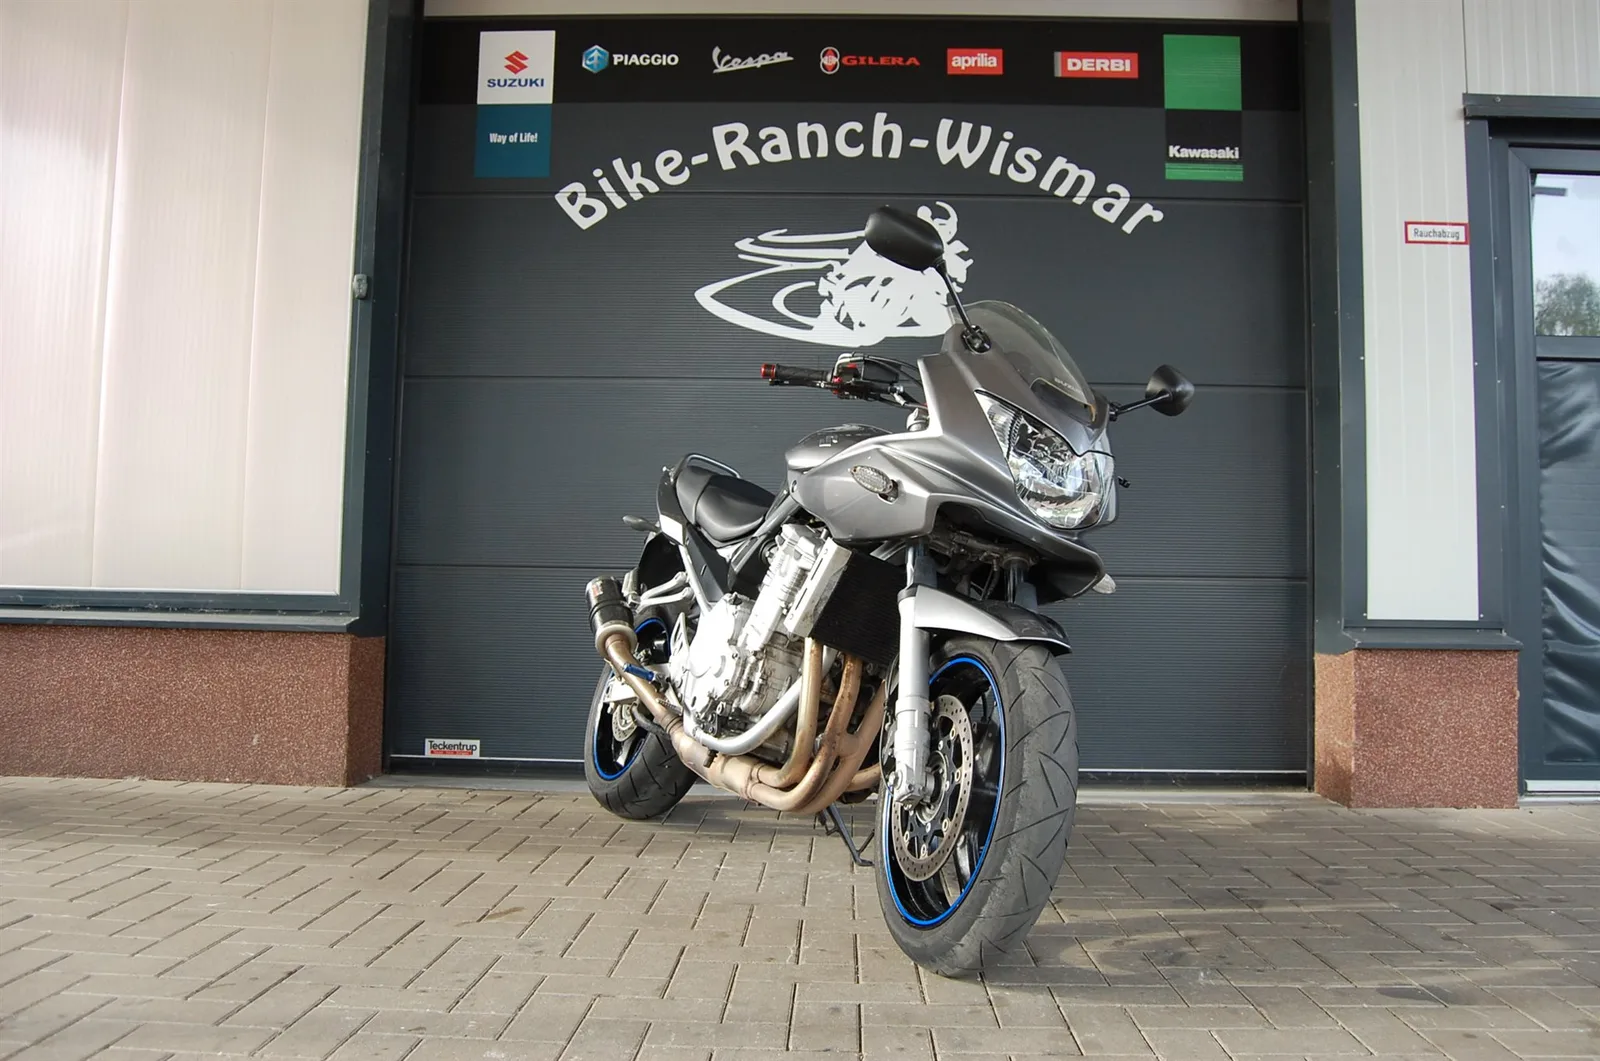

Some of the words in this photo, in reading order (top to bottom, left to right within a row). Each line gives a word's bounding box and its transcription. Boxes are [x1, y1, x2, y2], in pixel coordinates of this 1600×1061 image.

[612, 53, 680, 66] PIAGGIO
[712, 46, 794, 74] Vespa
[841, 55, 921, 66] GILERA
[951, 53, 998, 70] aprilia
[1067, 58, 1131, 72] DERBI
[487, 78, 545, 88] SUZUKI
[489, 133, 507, 145] Way
[508, 133, 518, 143] of
[520, 132, 538, 143] Life!
[1168, 145, 1240, 159] Kawasaki
[1413, 228, 1460, 240] Rauchabzug
[428, 740, 477, 755] Teckentrup
